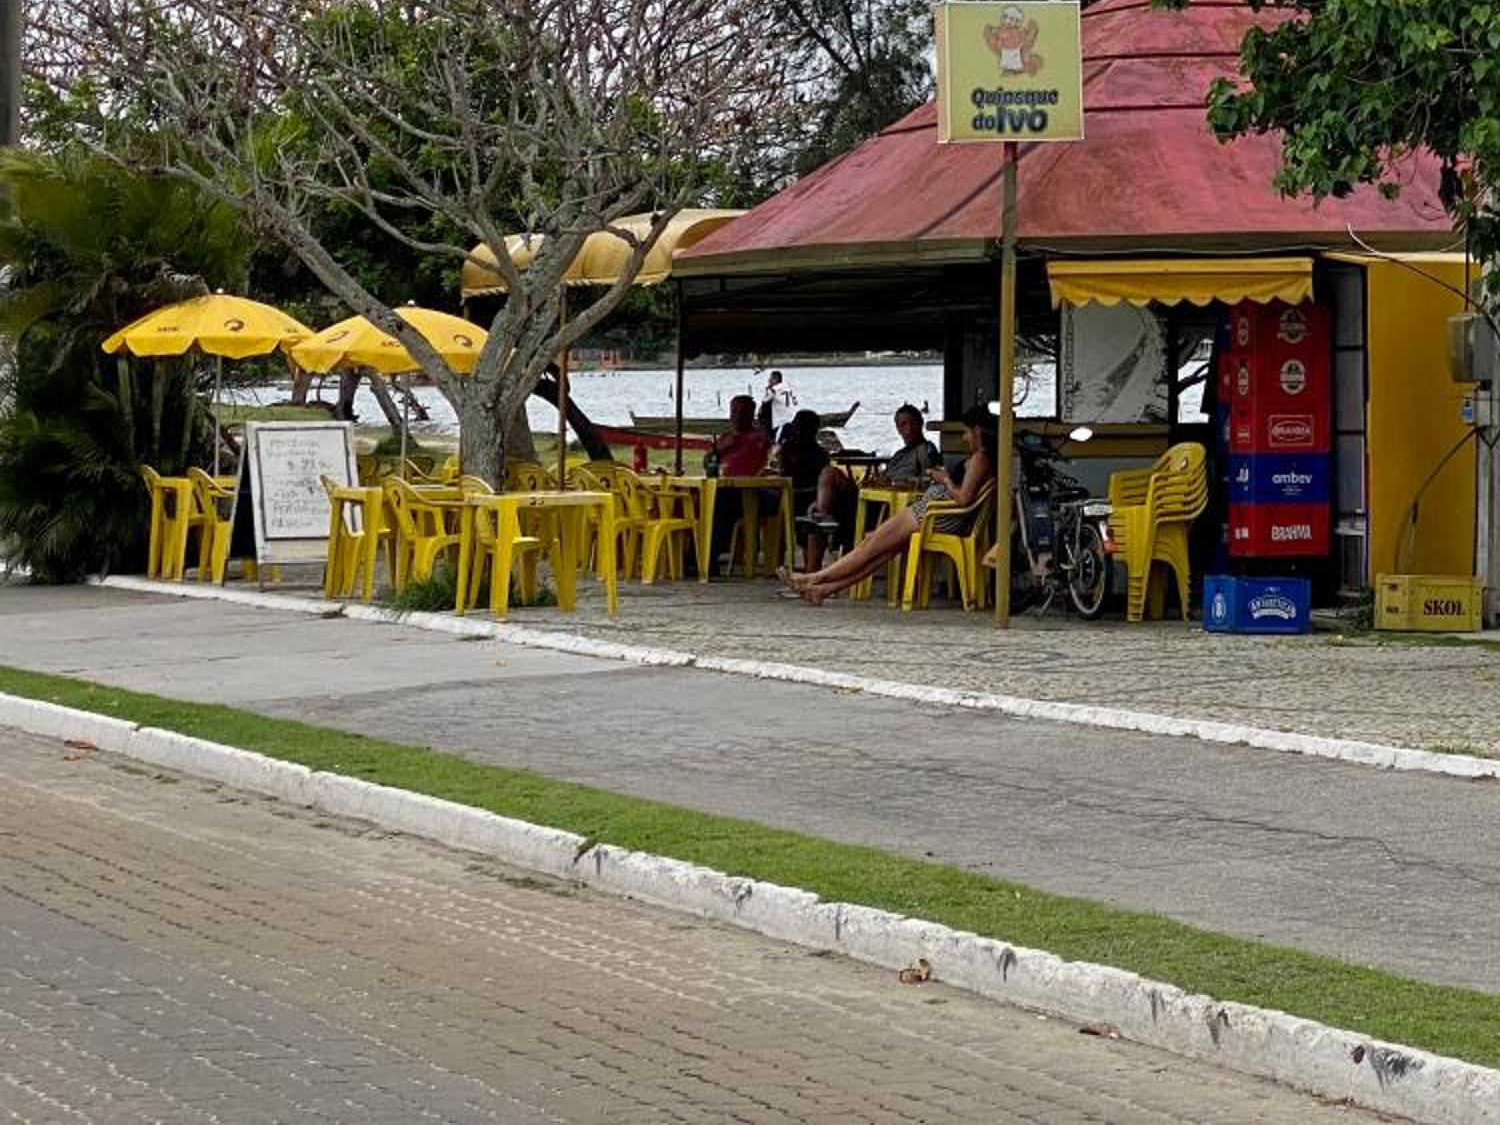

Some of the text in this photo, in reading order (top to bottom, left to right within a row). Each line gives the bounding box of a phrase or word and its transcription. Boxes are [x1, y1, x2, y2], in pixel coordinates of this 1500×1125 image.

[971, 86, 1058, 109] Quiosque
[1271, 471, 1313, 484] ambev
[1270, 525, 1312, 541] BRAHMA
[1423, 599, 1467, 616] SKOL
